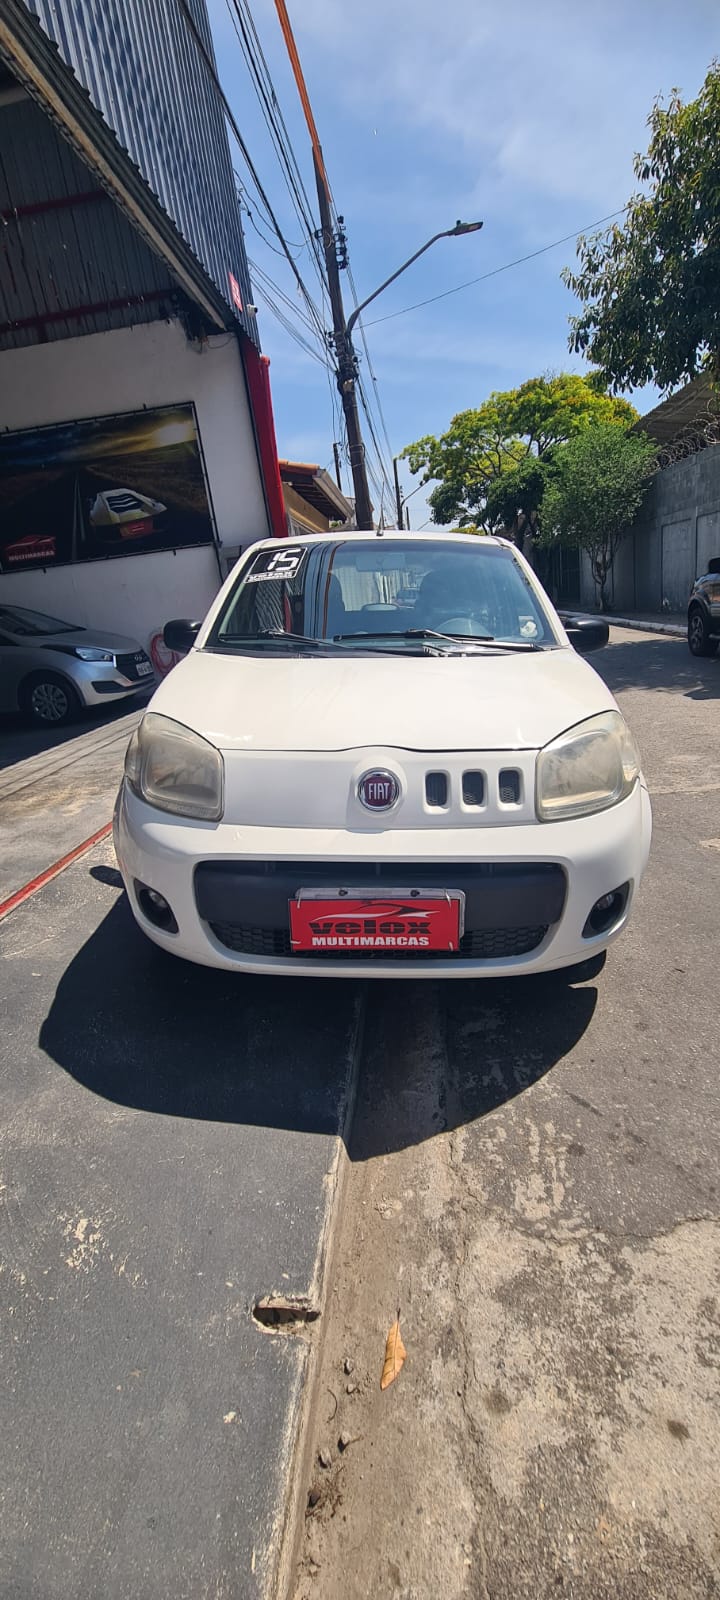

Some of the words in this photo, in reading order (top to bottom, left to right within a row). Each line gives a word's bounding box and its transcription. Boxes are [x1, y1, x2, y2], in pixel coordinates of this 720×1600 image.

[267, 548, 301, 571] 15
[368, 782, 390, 800] FIAT
[311, 936, 429, 946] MULTIMARCAS
